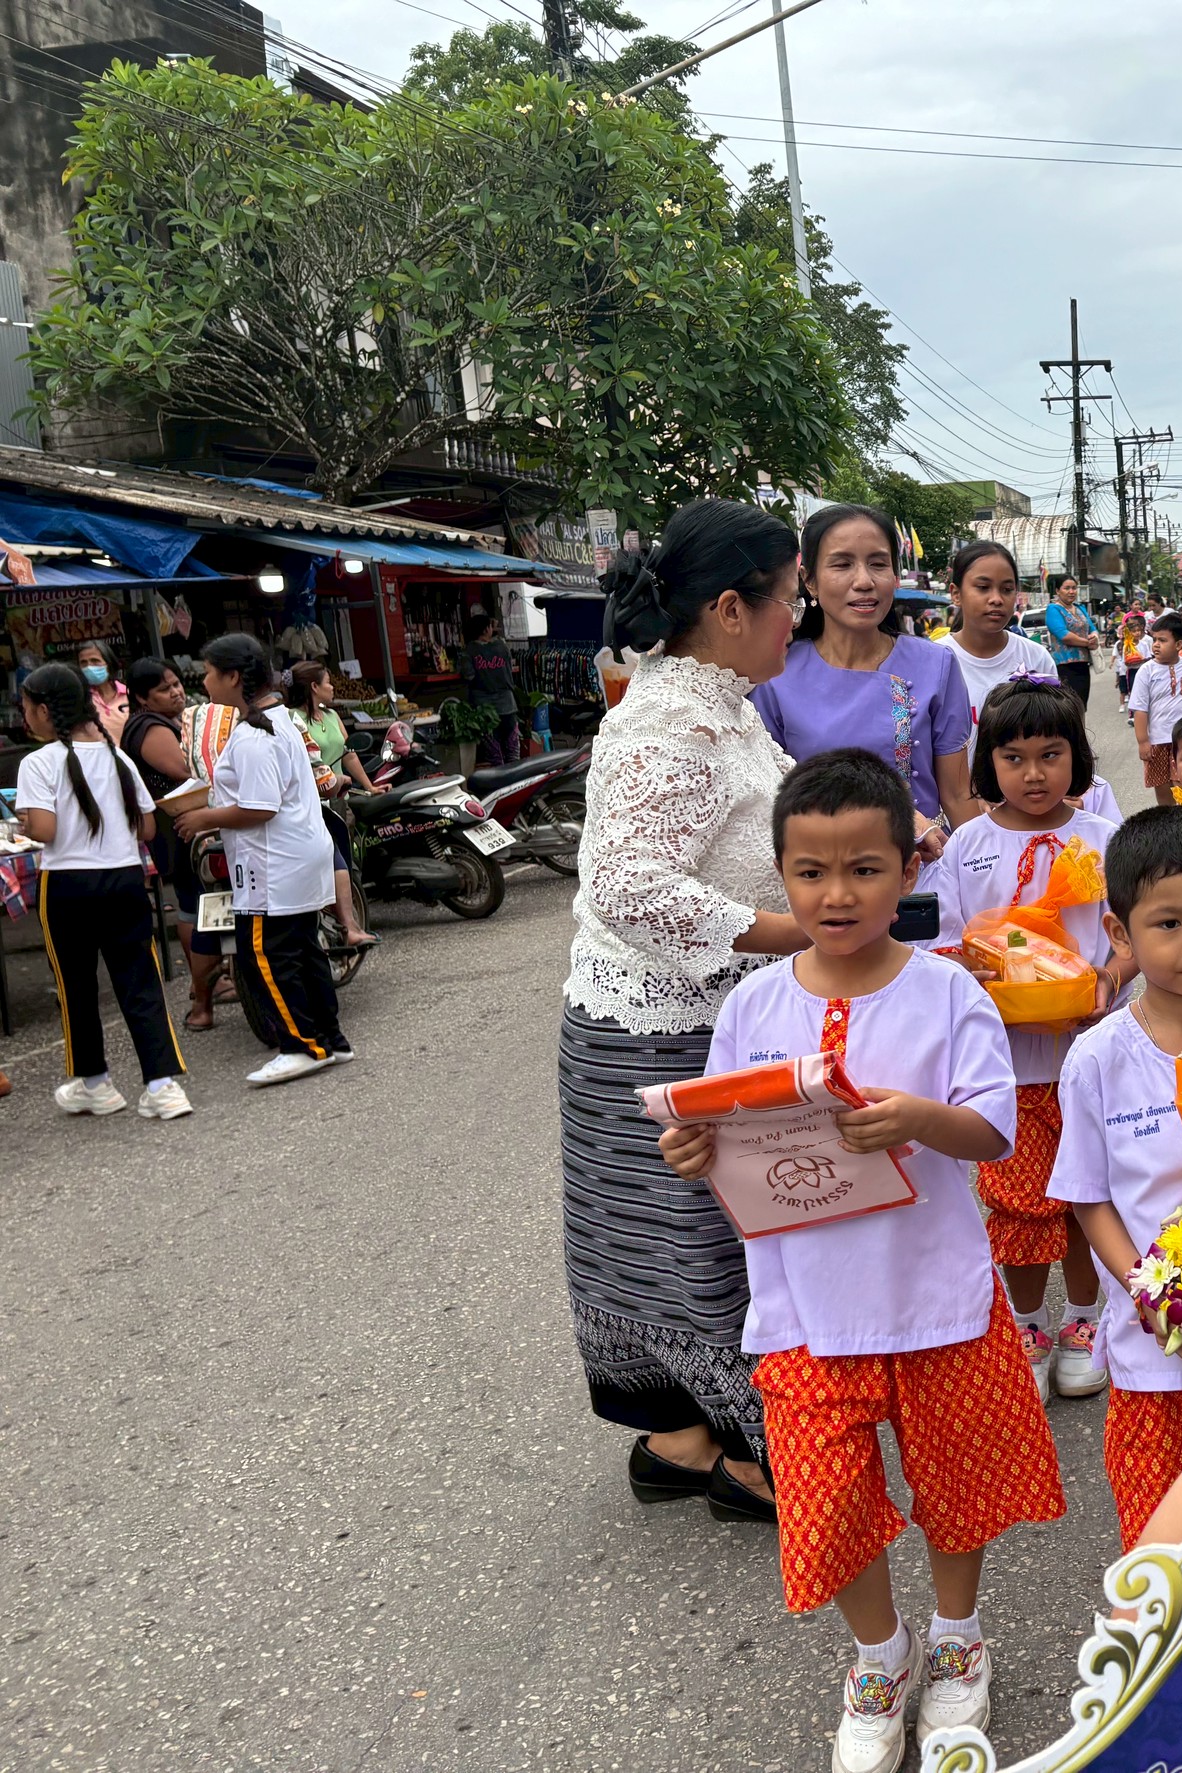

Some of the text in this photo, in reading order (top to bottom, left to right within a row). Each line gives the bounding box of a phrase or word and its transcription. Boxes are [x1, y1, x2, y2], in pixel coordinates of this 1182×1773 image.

[741, 1123, 822, 1146] Tham Pa Pon
